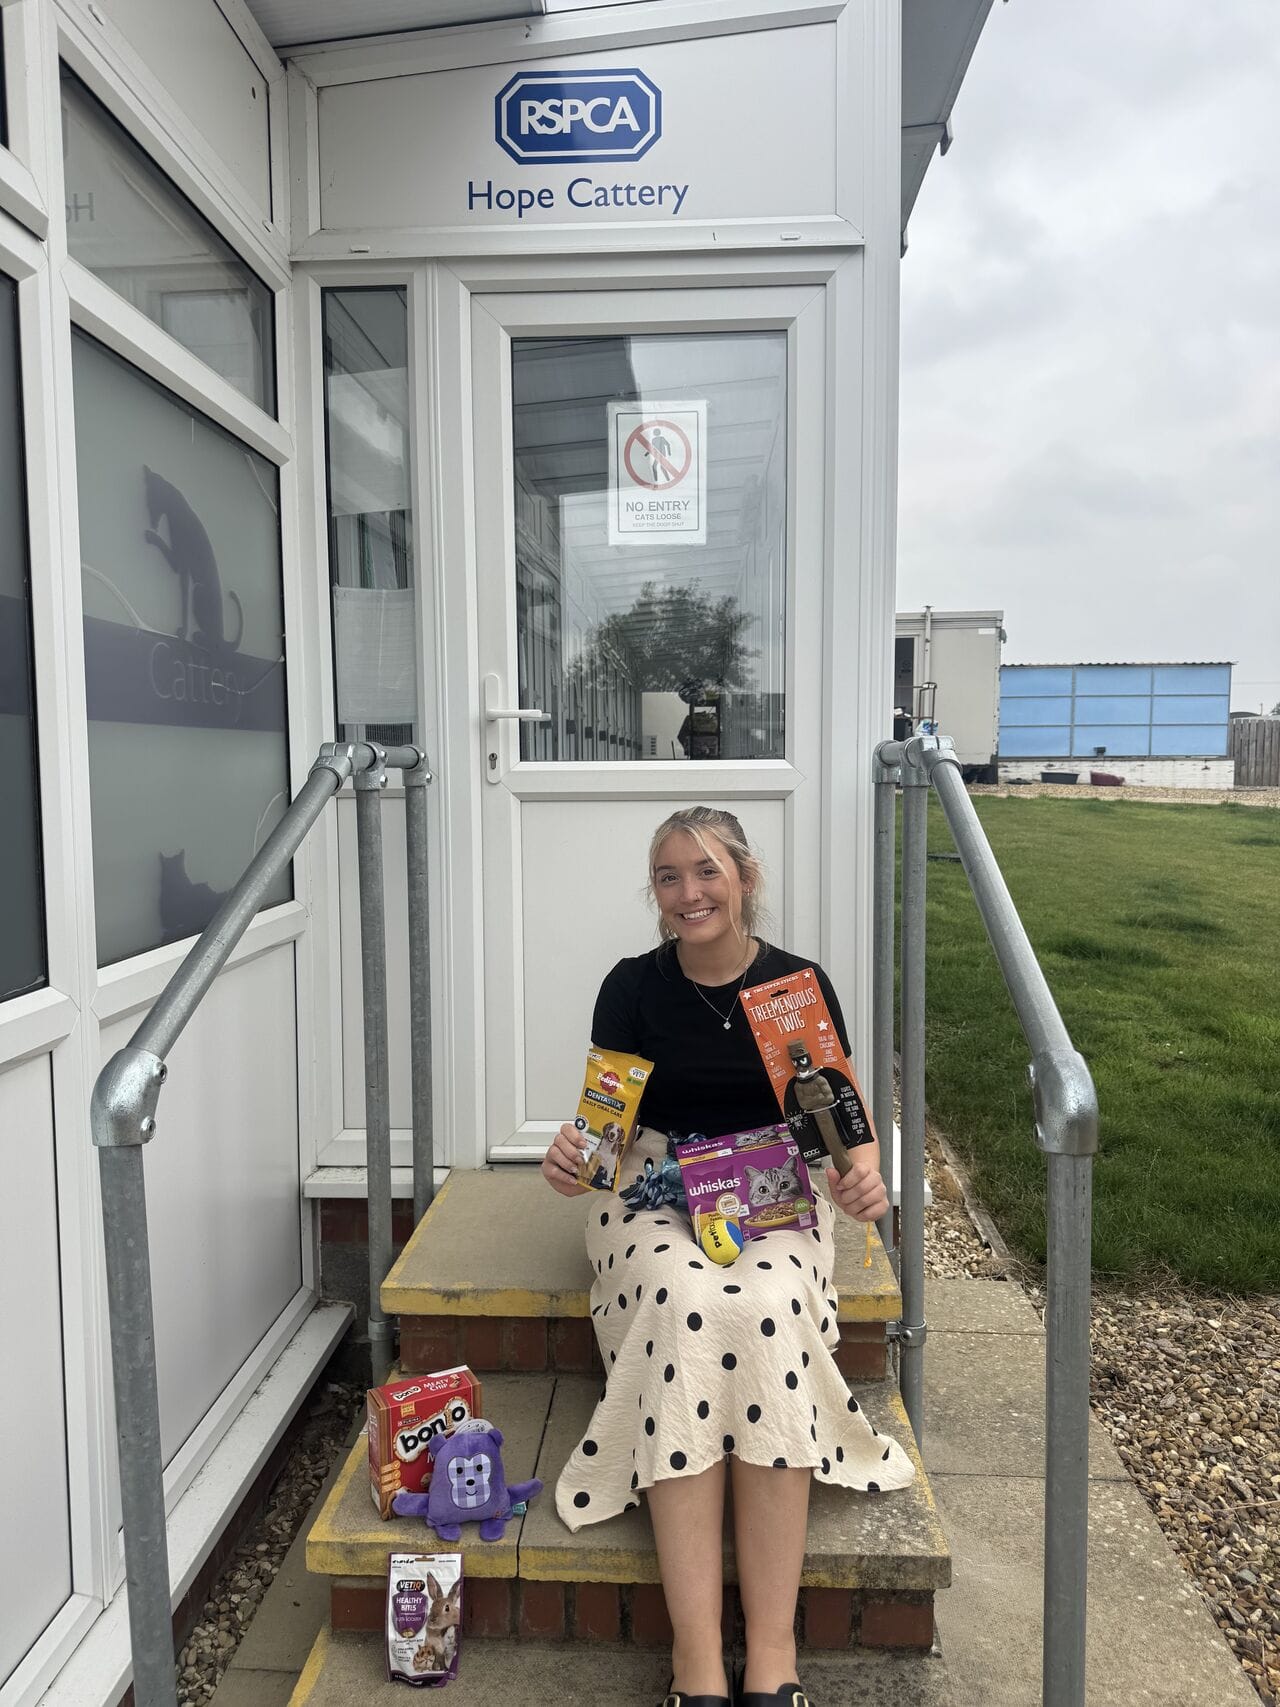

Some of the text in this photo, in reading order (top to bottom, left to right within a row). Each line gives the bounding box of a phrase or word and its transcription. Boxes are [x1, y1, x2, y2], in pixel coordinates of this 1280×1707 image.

[519, 96, 641, 136] RSPCA
[467, 177, 690, 219] Hope Cattery
[626, 500, 690, 512] NO ENTRY
[634, 512, 682, 521] CATS LOOSE
[748, 987, 818, 1024] TREEMENDOUS
[773, 1011, 806, 1035] TWIG
[586, 1089, 624, 1110] DENTASTIX
[681, 1141, 724, 1155] whiskas
[688, 1177, 742, 1198] whiskas
[423, 1378, 450, 1390] MEATY
[396, 1597, 423, 1605] HEALTHY
